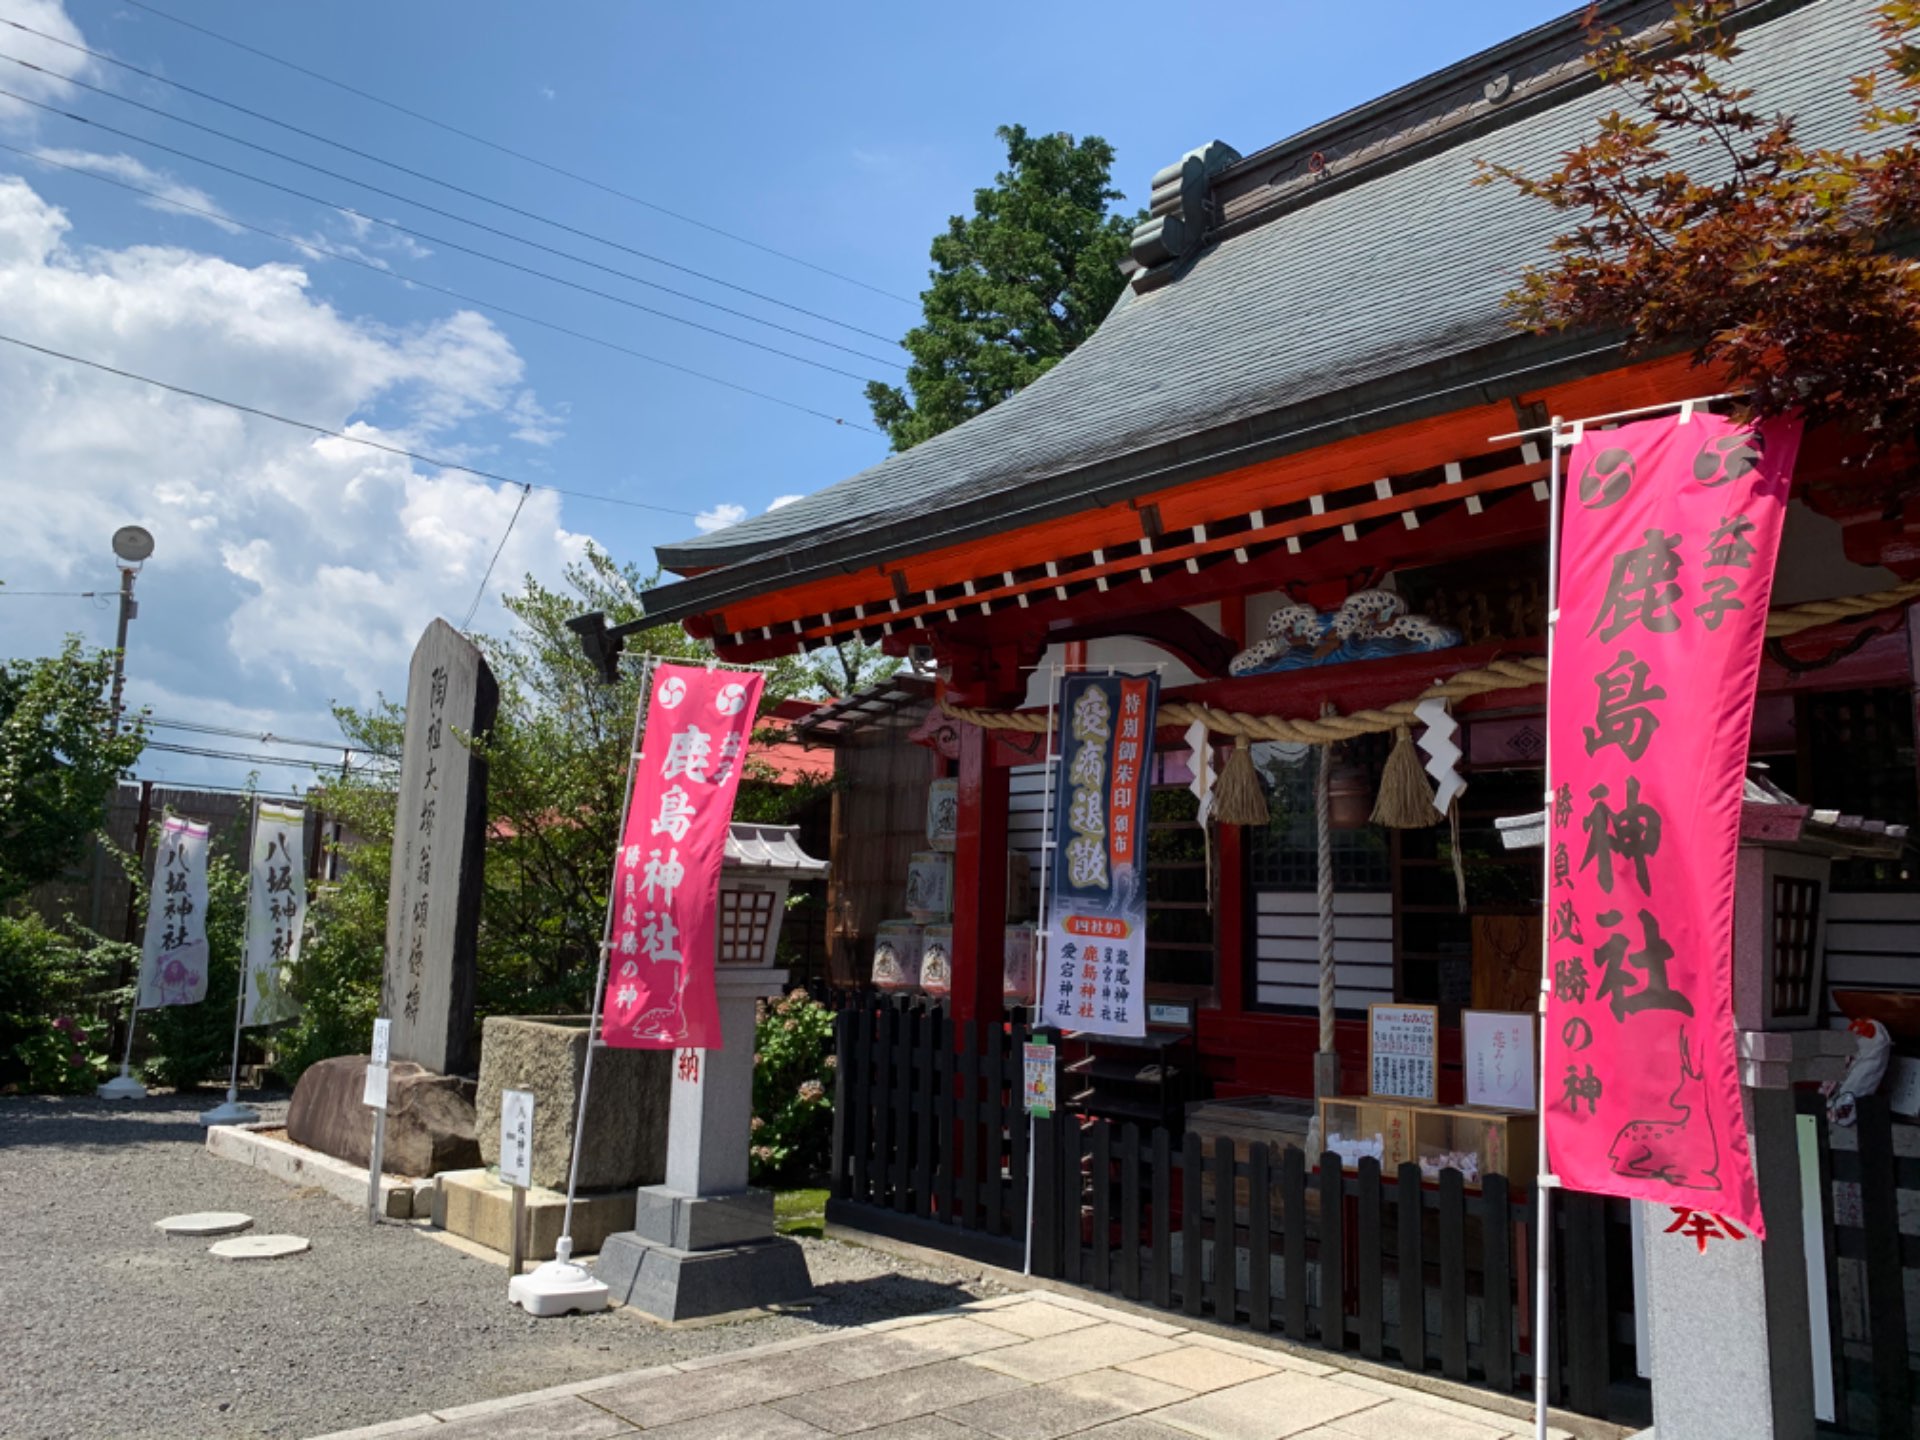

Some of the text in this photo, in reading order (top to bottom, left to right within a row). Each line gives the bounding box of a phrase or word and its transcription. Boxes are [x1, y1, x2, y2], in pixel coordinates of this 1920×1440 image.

[1692, 513, 1758, 632] 益子
[713, 730, 742, 788] 益子
[1068, 687, 1108, 887] 疫病退散
[1579, 529, 1695, 1023] 鹿島神社
[161, 842, 193, 951] 八坂神社
[265, 831, 298, 960] 八坂神社
[615, 844, 640, 1010] 勝負必勝の神
[638, 724, 712, 964] 鹿島神社
[1552, 781, 1603, 1116] 勝負必勝の神
